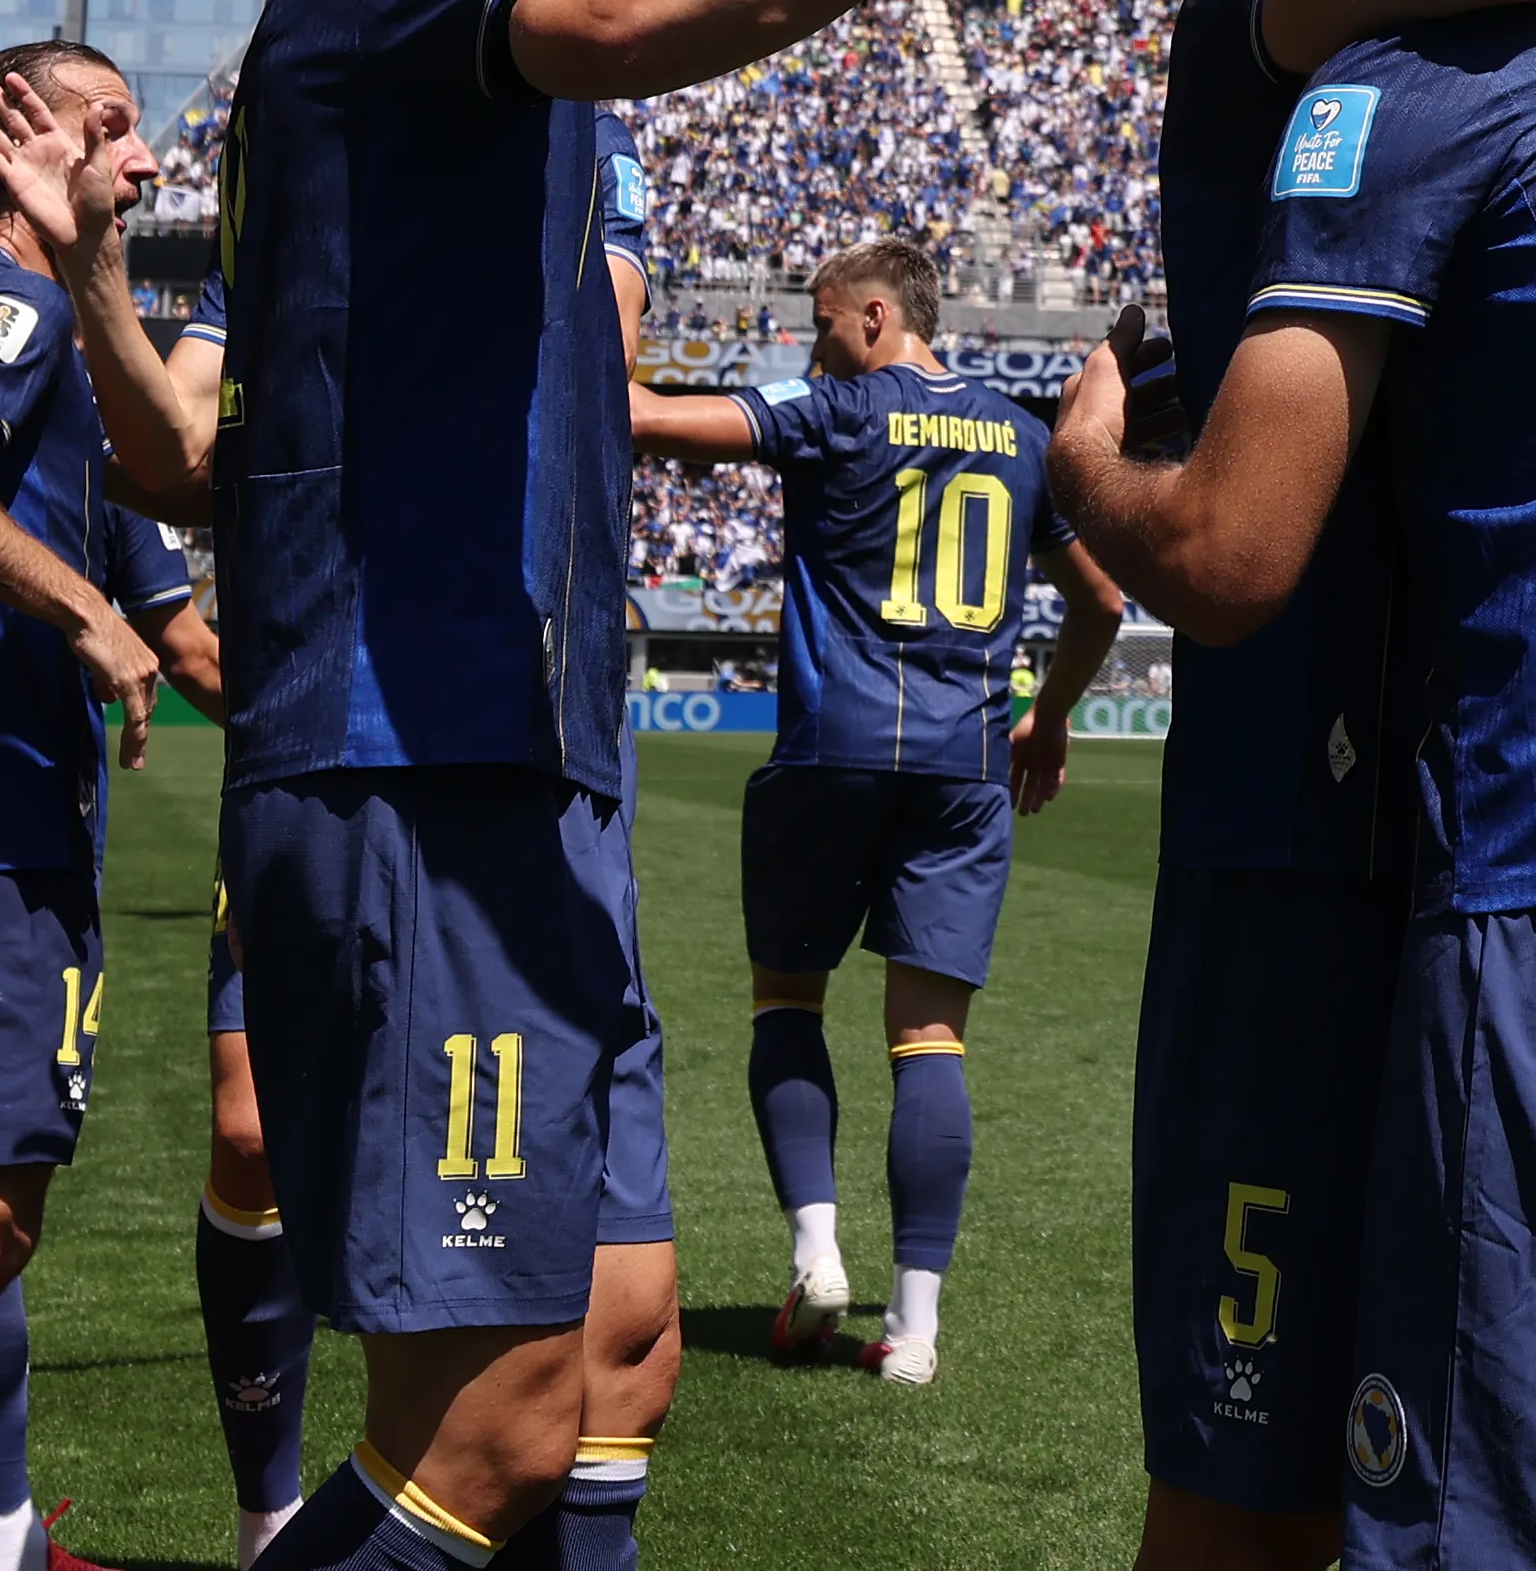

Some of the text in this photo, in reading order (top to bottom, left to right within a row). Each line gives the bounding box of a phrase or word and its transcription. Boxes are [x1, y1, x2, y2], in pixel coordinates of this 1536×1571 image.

[1294, 130, 1343, 153] Unite For
[1292, 151, 1336, 172] PEACE
[1296, 172, 1321, 184] FIFA
[888, 411, 1017, 458] DEMIROVIĆ
[881, 468, 1014, 634] 10
[437, 1033, 527, 1180] 11
[442, 1235, 506, 1248] KELME
[1218, 1181, 1291, 1350] 5
[1213, 1402, 1269, 1425] KELME
